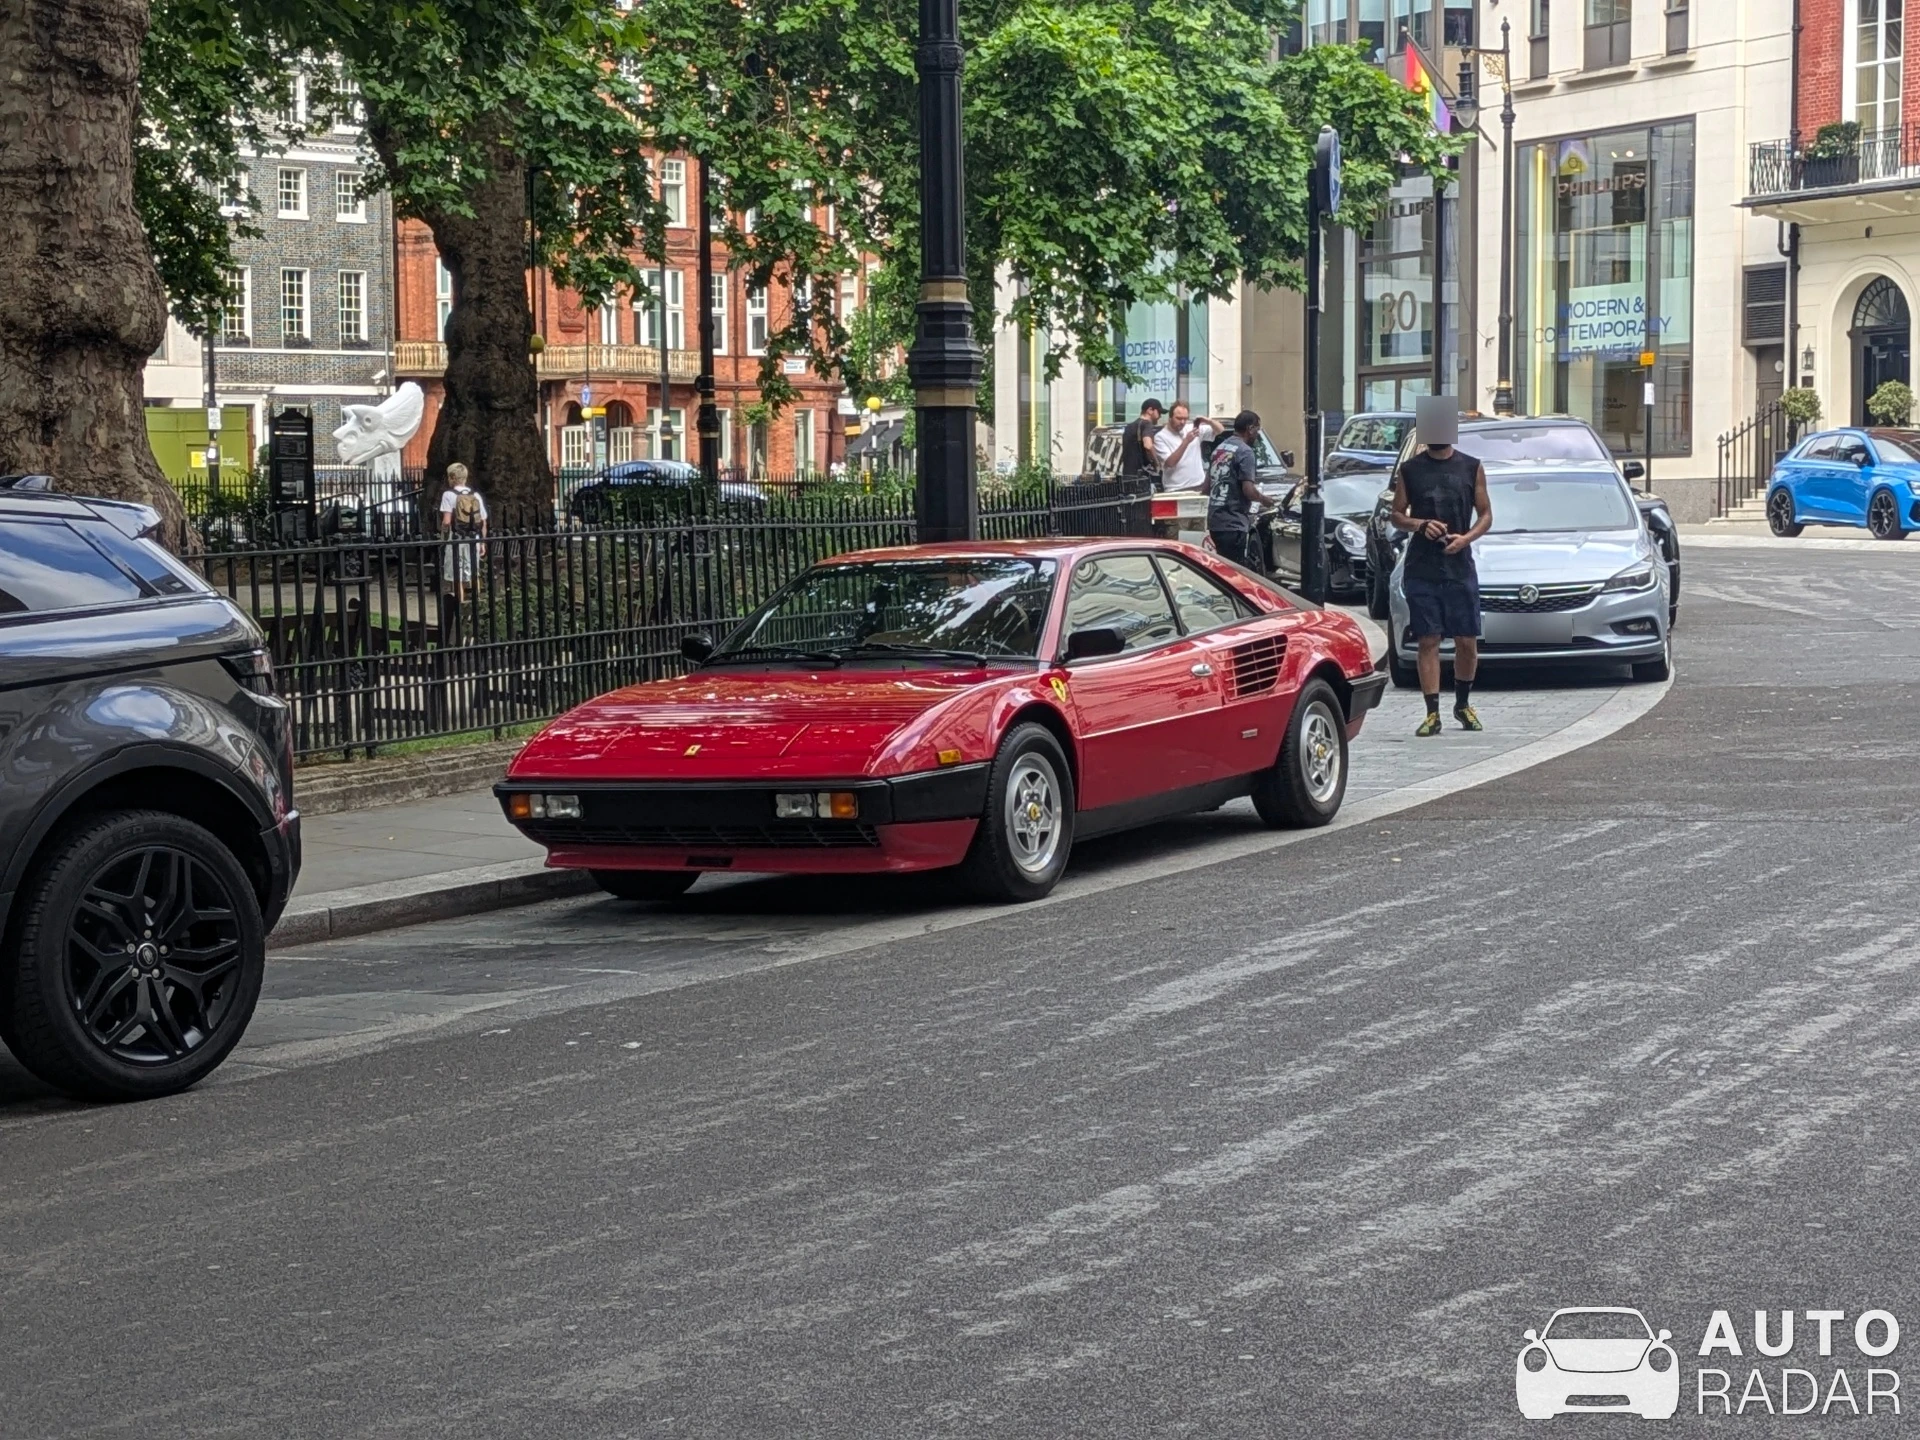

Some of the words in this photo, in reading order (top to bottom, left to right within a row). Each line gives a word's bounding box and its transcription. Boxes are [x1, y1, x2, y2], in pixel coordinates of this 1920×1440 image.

[1558, 172, 1645, 198] PHILLIPS
[1368, 200, 1434, 220] HILLIPS
[1633, 296, 1645, 313] &
[1533, 315, 1672, 343] COTEMPORAY
[1120, 340, 1166, 357] ODERN
